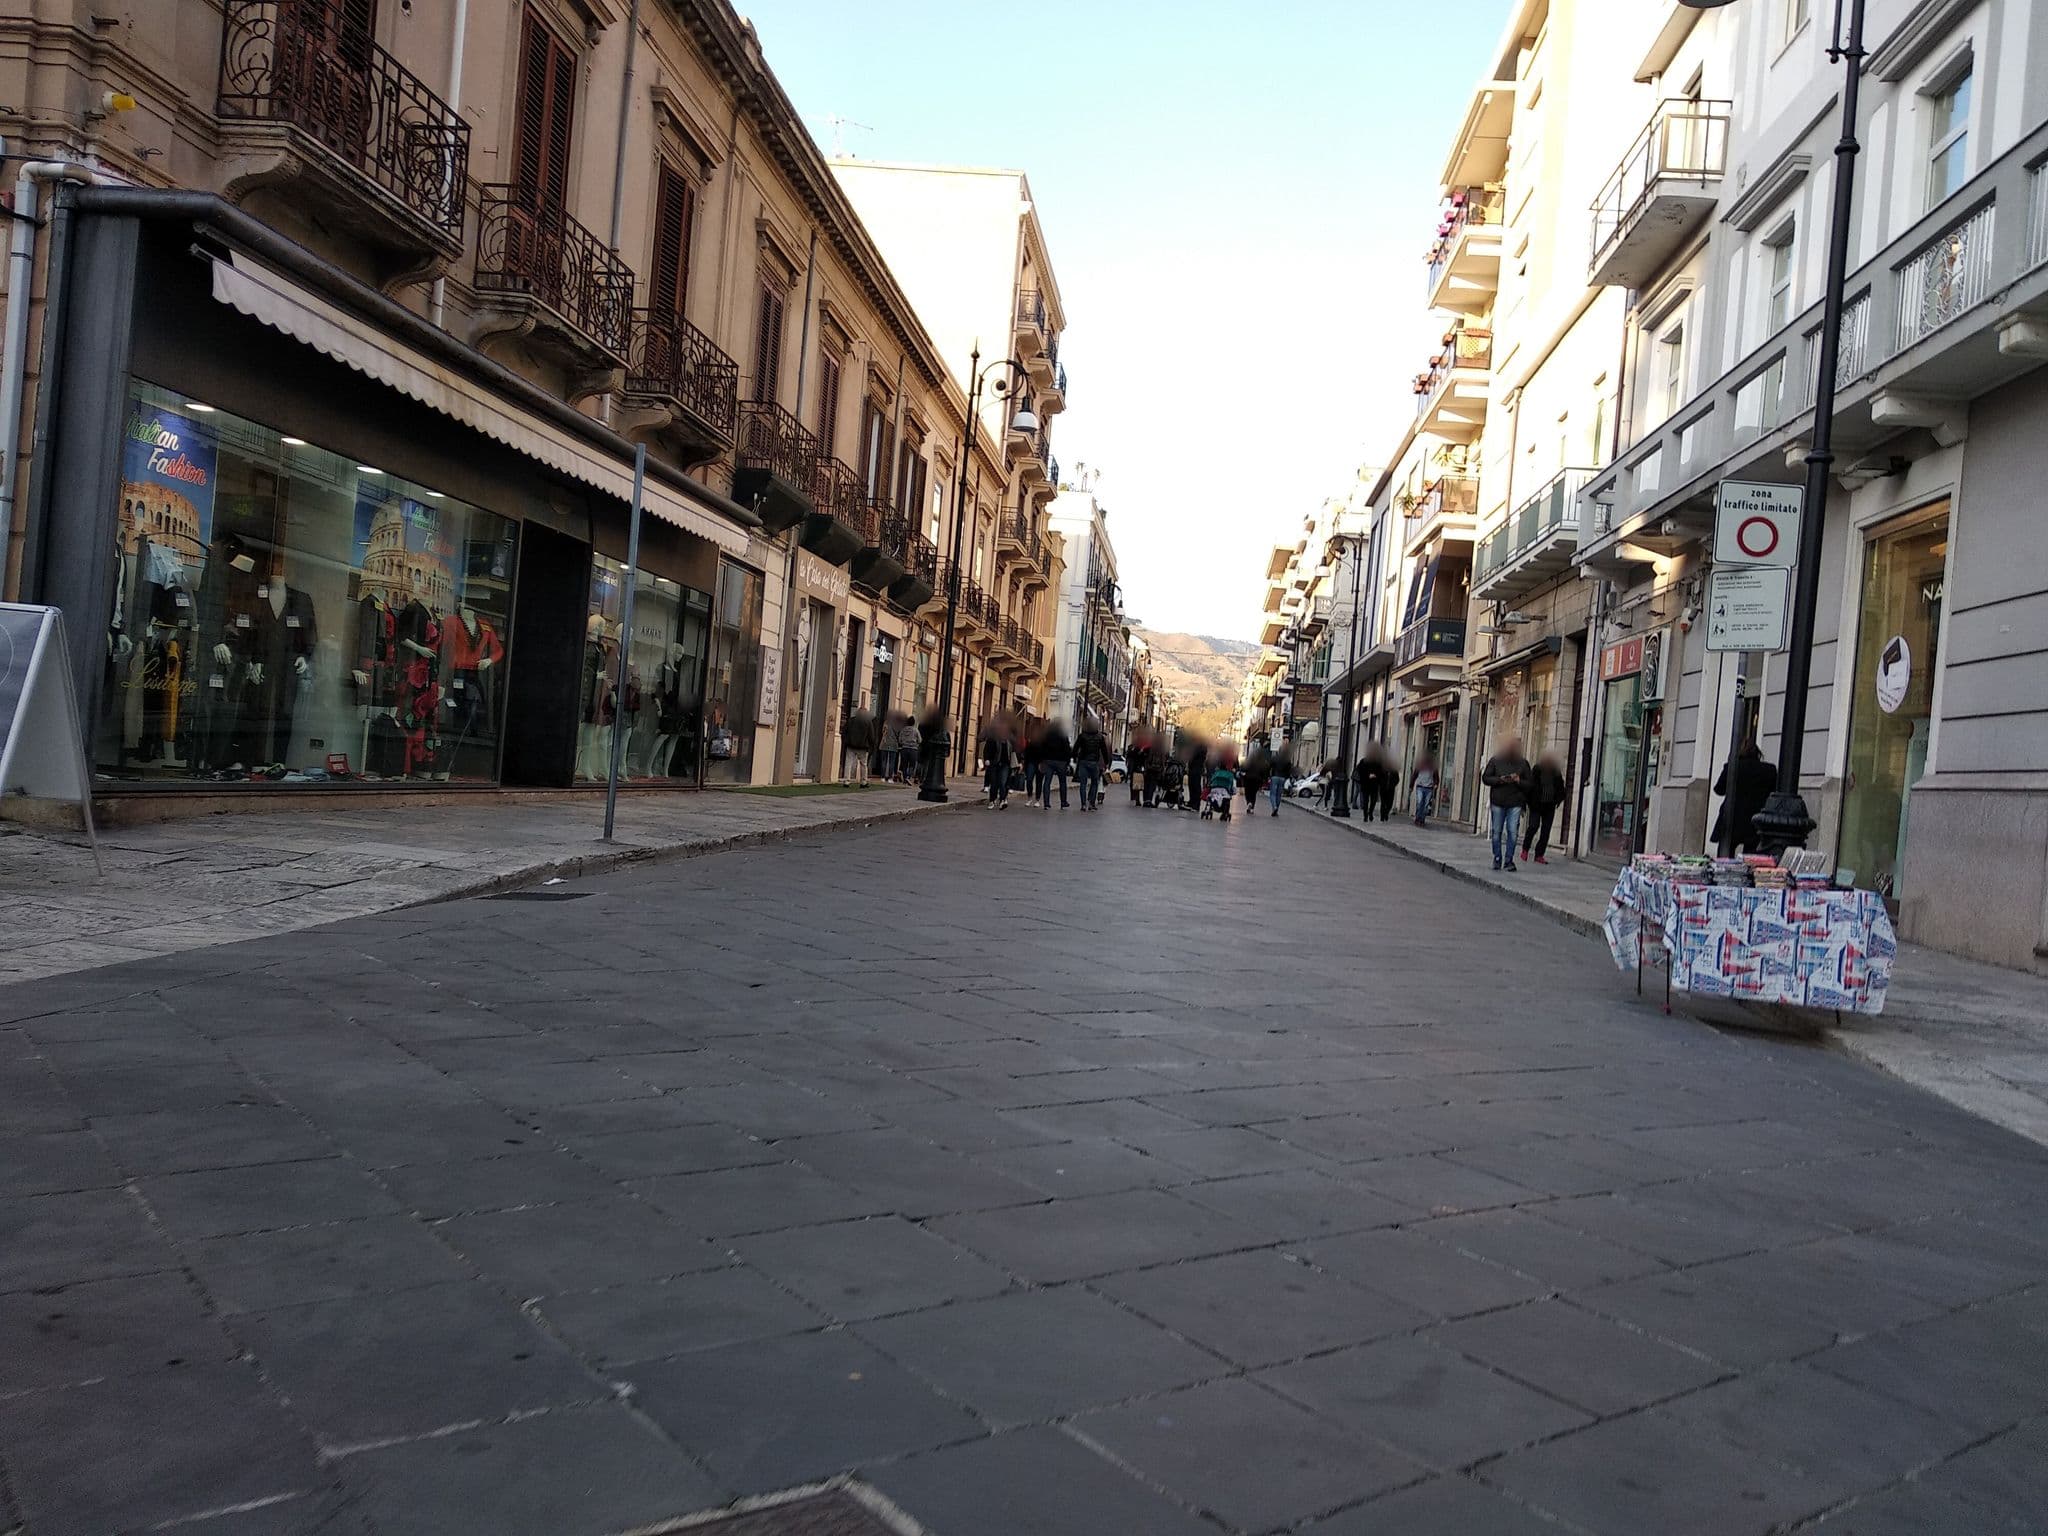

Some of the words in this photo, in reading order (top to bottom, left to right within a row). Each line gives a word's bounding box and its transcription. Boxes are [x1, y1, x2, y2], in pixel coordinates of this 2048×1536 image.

[147, 447, 207, 486] Fashion
[1751, 489, 1772, 498] zona
[1724, 500, 1759, 511] traffico
[1761, 501, 1798, 514] limitato
